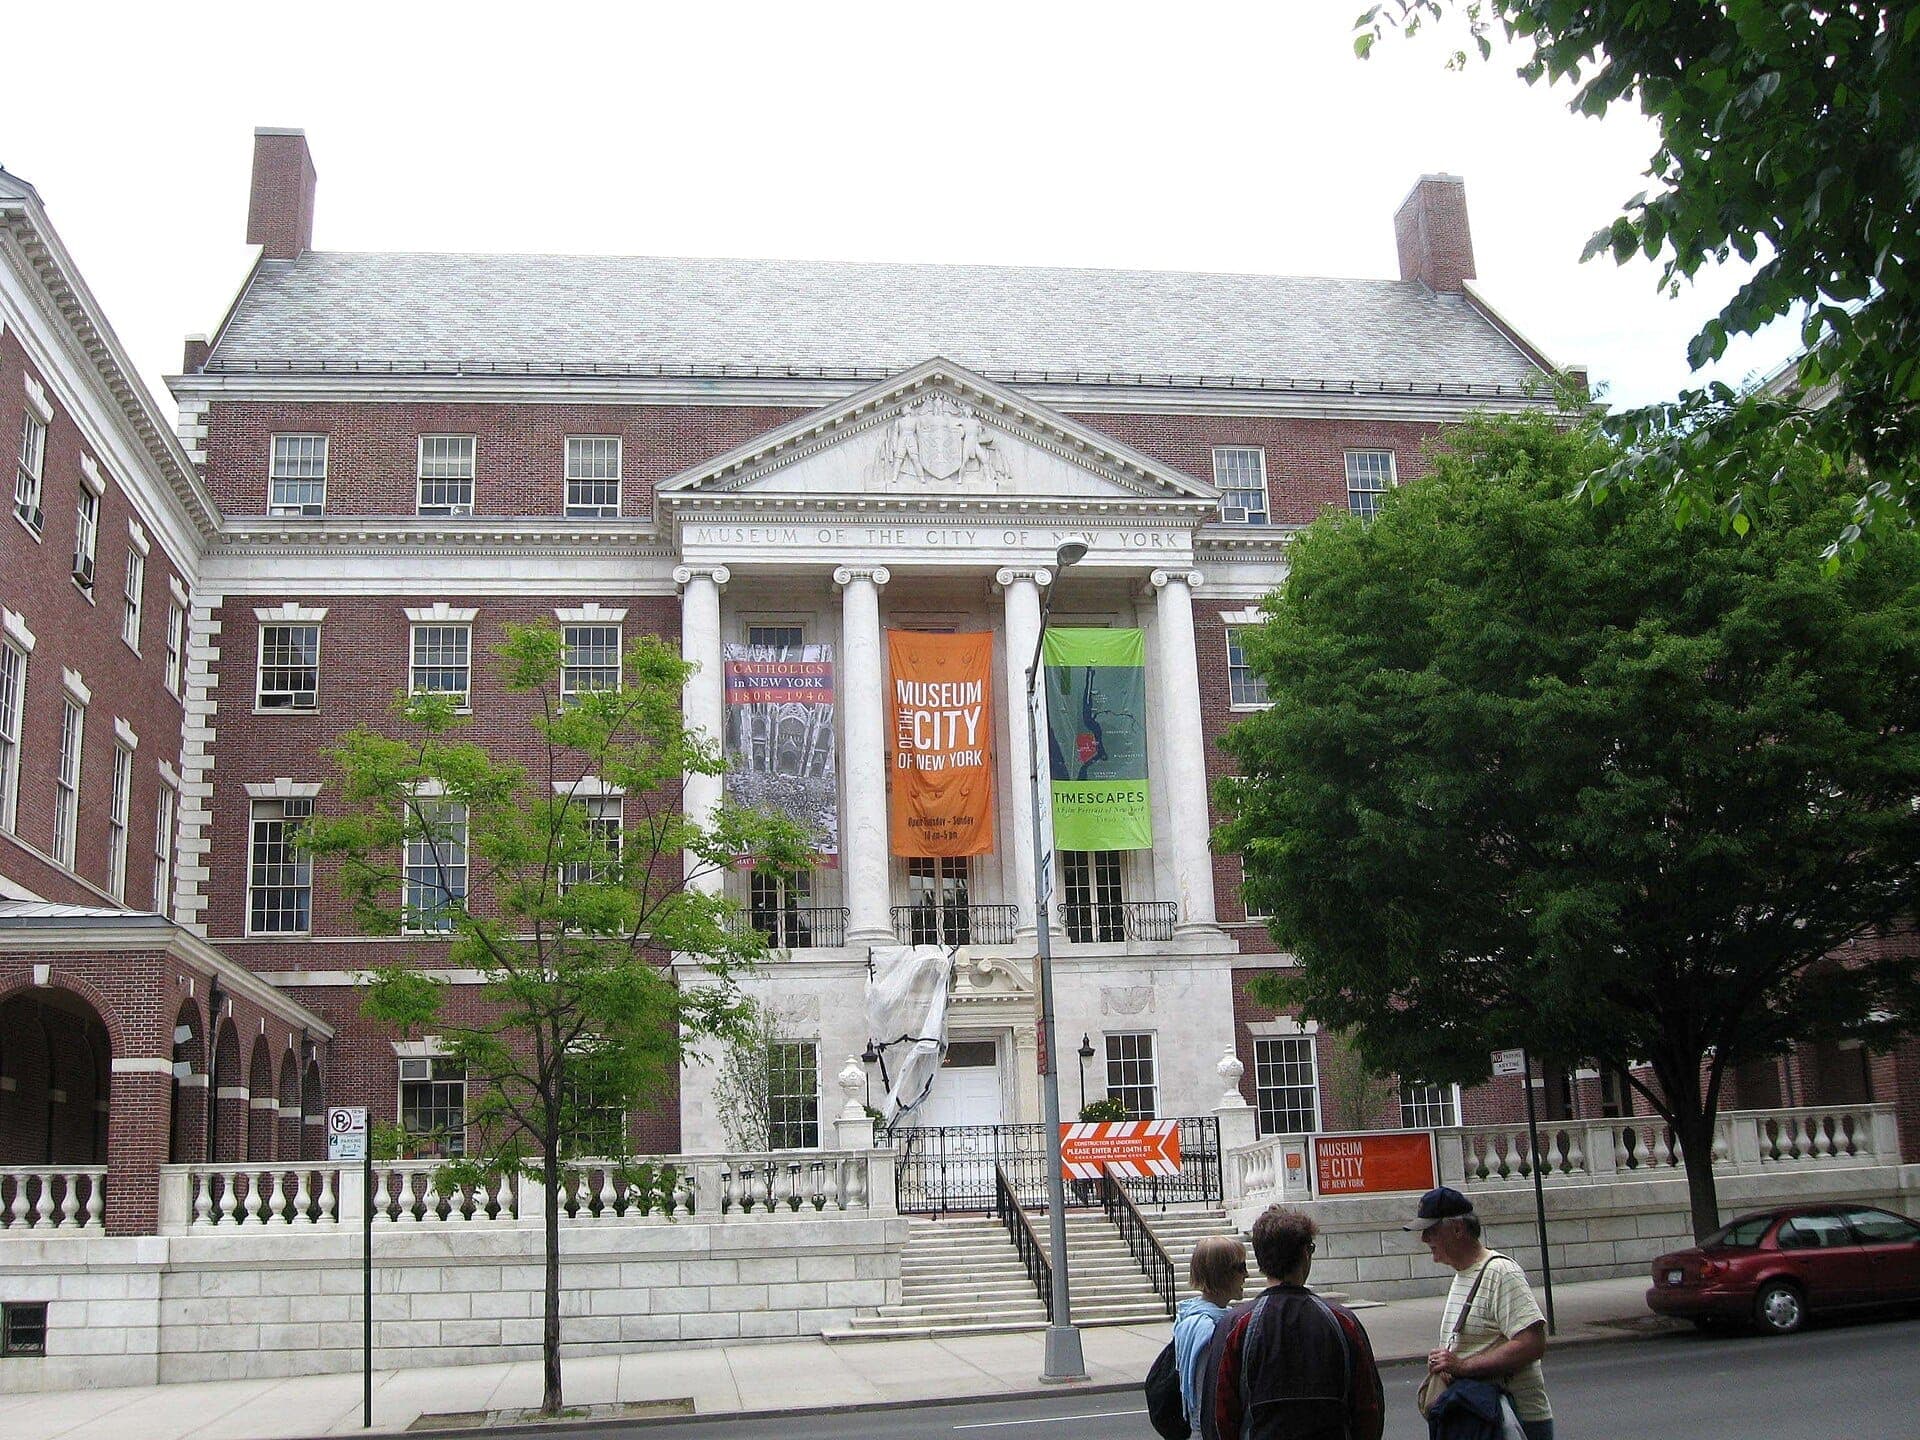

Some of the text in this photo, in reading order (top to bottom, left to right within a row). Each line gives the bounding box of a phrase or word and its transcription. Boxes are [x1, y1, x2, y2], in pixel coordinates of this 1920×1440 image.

[697, 528, 799, 544] MUSEUM
[818, 529, 846, 544] OF
[866, 529, 907, 545] THE
[925, 529, 977, 545] CITY
[1003, 530, 1029, 546] OF
[1119, 531, 1179, 548] YORK
[733, 664, 824, 674] CATHOLICS
[734, 677, 823, 688] in NEW YORK
[896, 679, 983, 708] MUSEUM
[898, 707, 913, 749] OF THE
[913, 706, 982, 751] CITY
[898, 750, 983, 771] OF NEW YORK
[1054, 791, 1145, 804] TIMESCAPES
[952, 815, 974, 827] Sunday
[1492, 1053, 1502, 1063] NO
[1074, 1140, 1109, 1148] CONSTRUCTION
[1319, 1142, 1363, 1157] MUSEUM
[1066, 1147, 1091, 1155] PLEASE
[1331, 1157, 1364, 1178] CITY
[1322, 1179, 1365, 1190] OF NEW YORK
